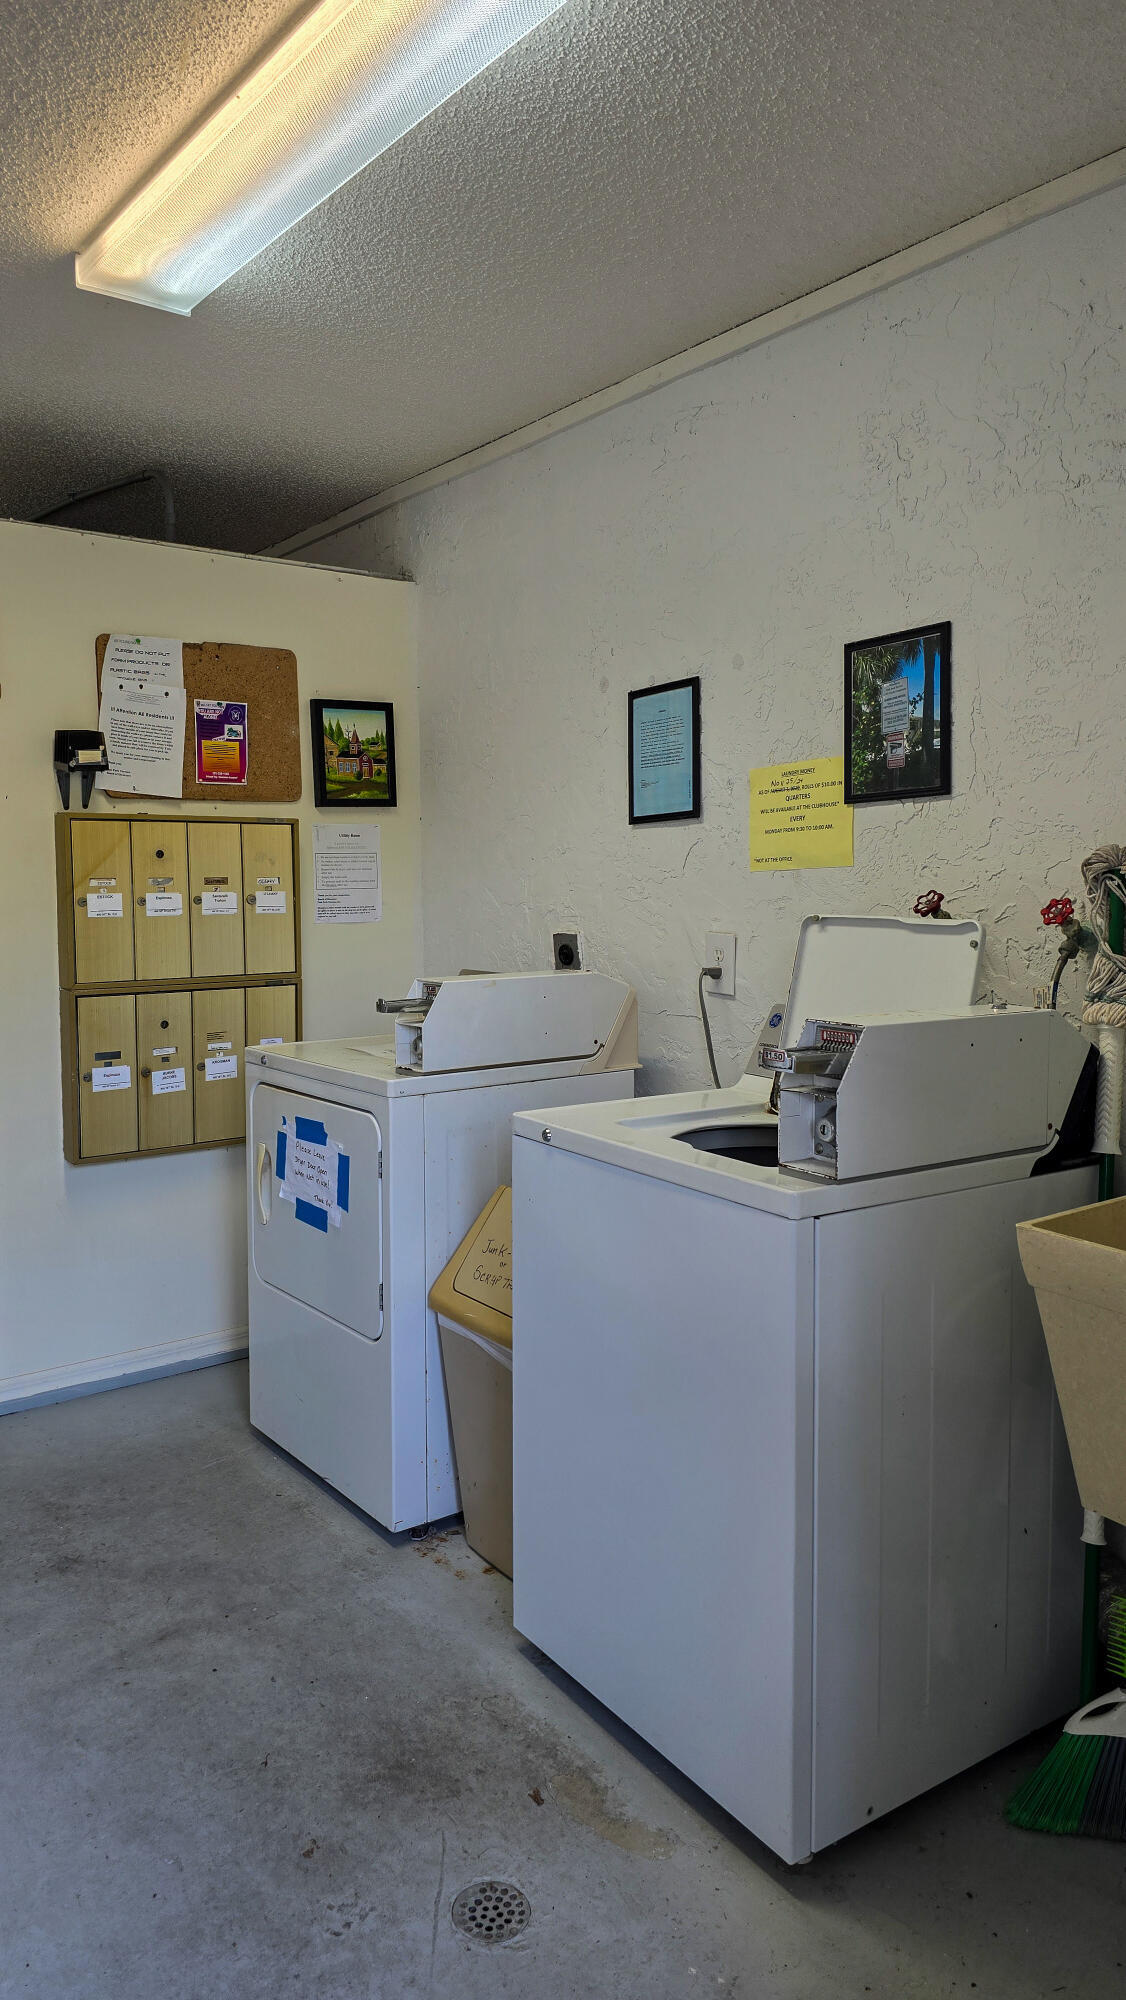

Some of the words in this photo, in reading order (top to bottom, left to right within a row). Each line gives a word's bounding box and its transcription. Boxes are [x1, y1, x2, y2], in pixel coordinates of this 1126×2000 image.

[785, 792, 811, 802] QUARTERS
[764, 1051, 782, 1060] $1.50
[296, 1140, 311, 1155] Please
[316, 1166, 328, 1176] Open
